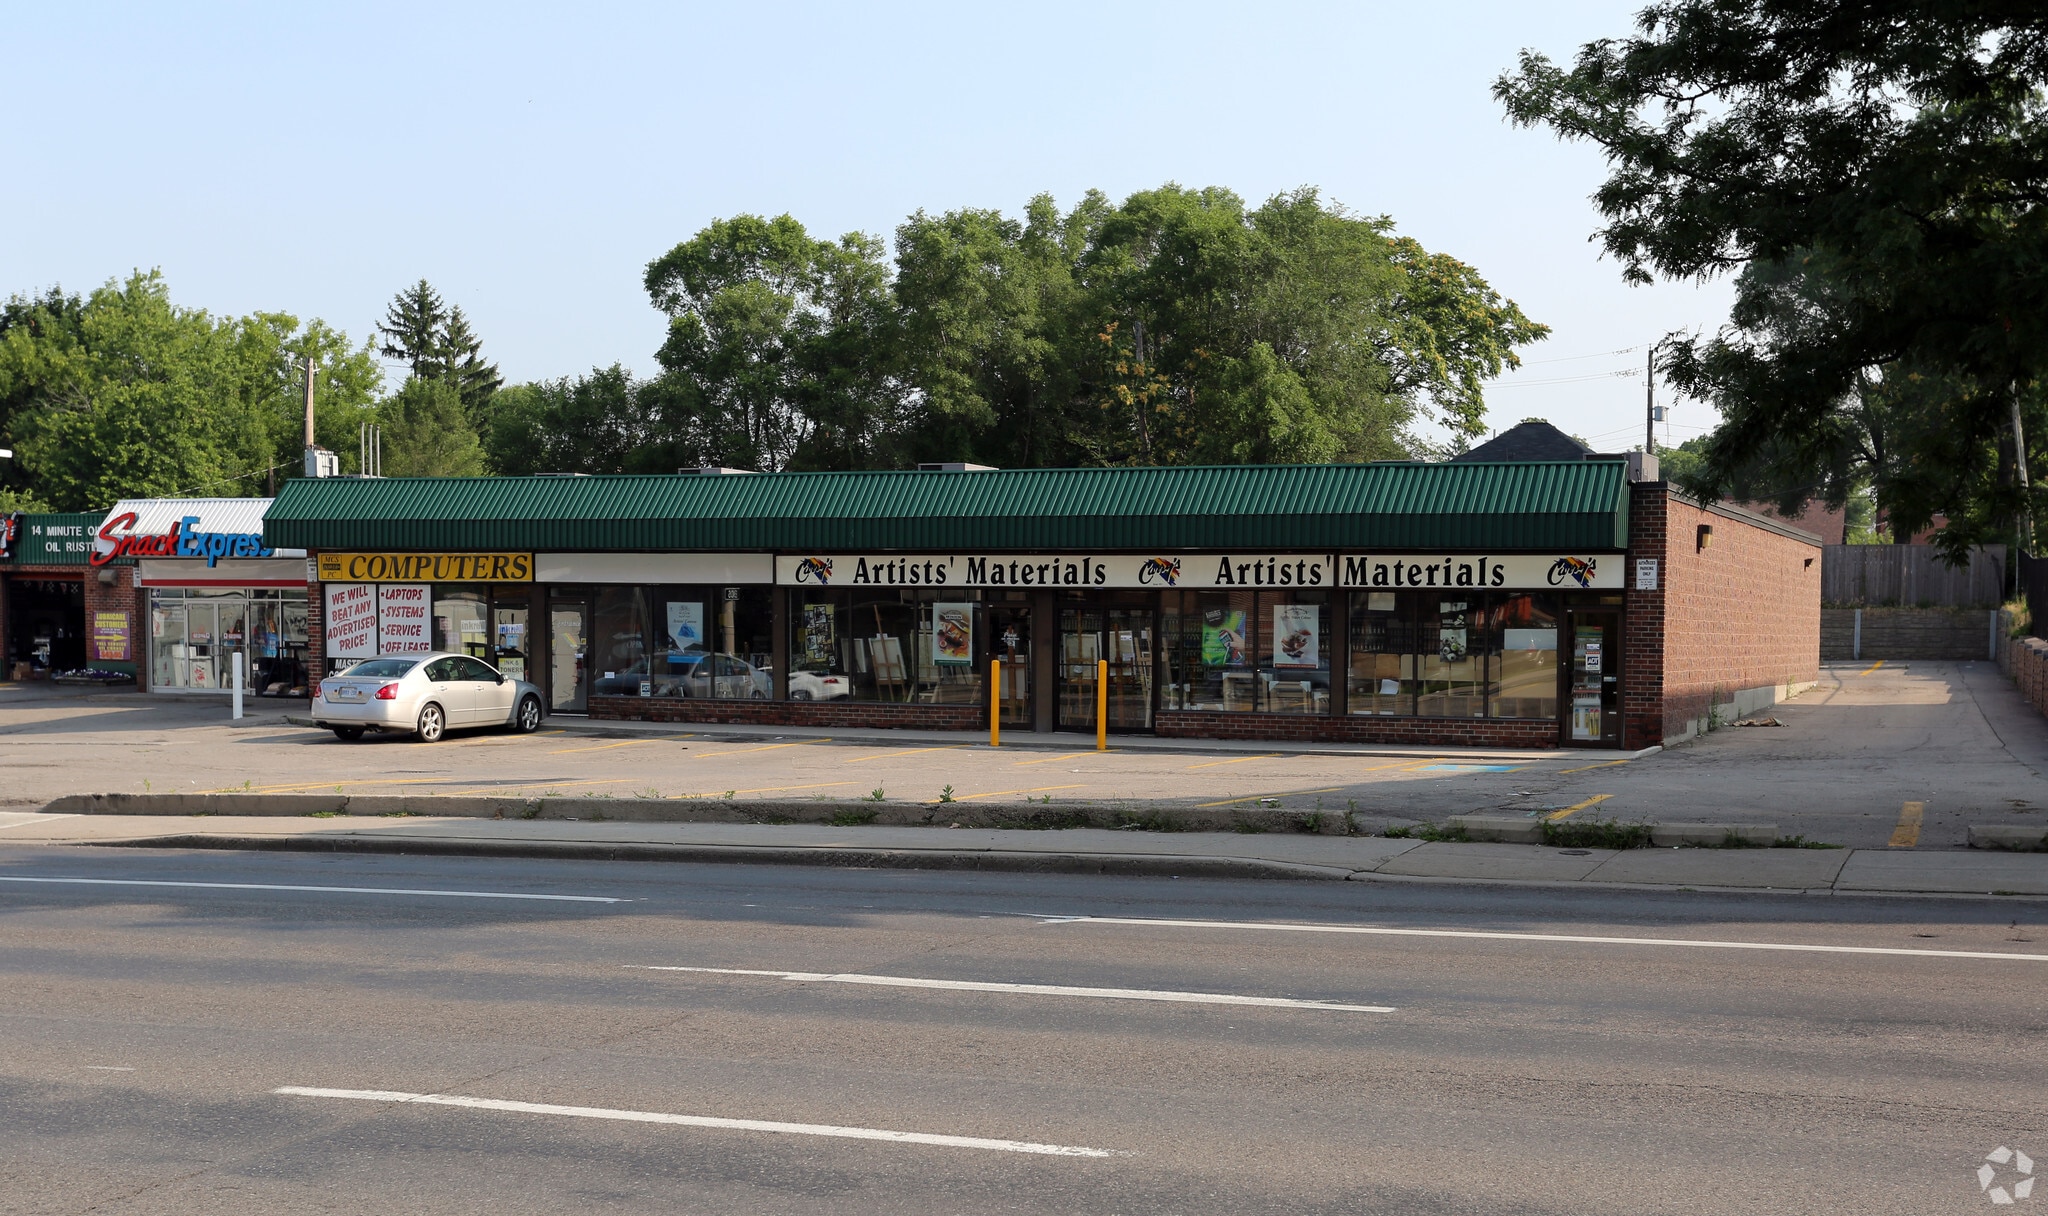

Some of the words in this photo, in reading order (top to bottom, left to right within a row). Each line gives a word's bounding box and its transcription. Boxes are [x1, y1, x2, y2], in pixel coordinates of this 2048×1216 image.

[31, 525, 41, 535] 14
[46, 526, 82, 536] MINUTE
[89, 512, 180, 566] Snack
[45, 541, 61, 552] OIL
[349, 555, 528, 579] COMPUTERS
[853, 556, 954, 585] Artists'
[966, 556, 1106, 585] Materials
[1215, 555, 1331, 585] Artists'
[1343, 556, 1505, 587] Materials
[332, 591, 345, 606] WE
[347, 585, 368, 601] WILL
[385, 589, 423, 601] LAPTOPS
[332, 605, 353, 622] BEAT
[354, 600, 371, 615] ANY
[385, 606, 425, 618] SYSTEMS
[327, 615, 376, 640] ADVERTISED
[385, 624, 422, 636] SERVICE
[339, 633, 368, 651] PRICE!
[385, 641, 401, 652] OFF
[403, 642, 429, 651] LEASE
